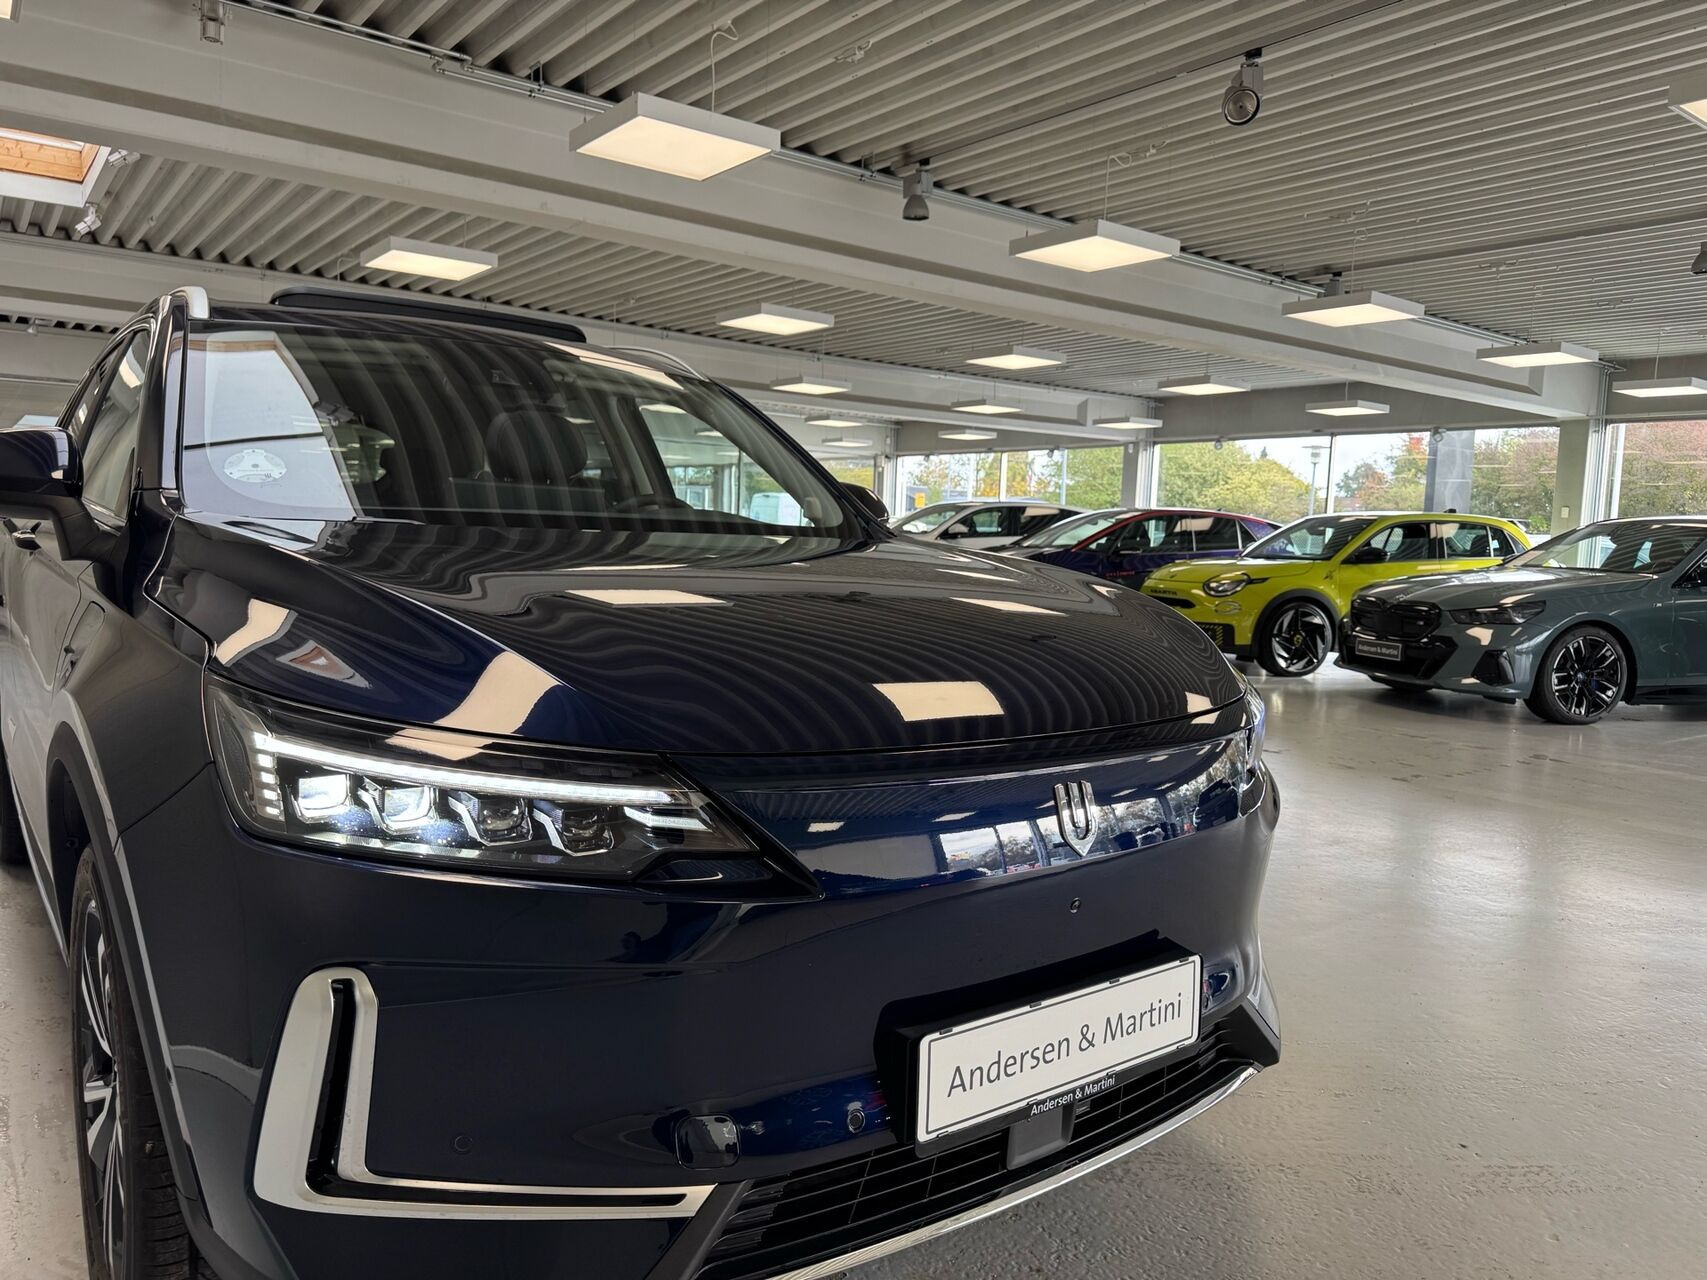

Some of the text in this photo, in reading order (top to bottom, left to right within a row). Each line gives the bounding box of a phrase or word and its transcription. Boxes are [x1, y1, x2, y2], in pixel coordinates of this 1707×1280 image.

[947, 992, 1182, 1098] Andersen & Martini
[1030, 1074, 1116, 1116] Andersen & Martini
